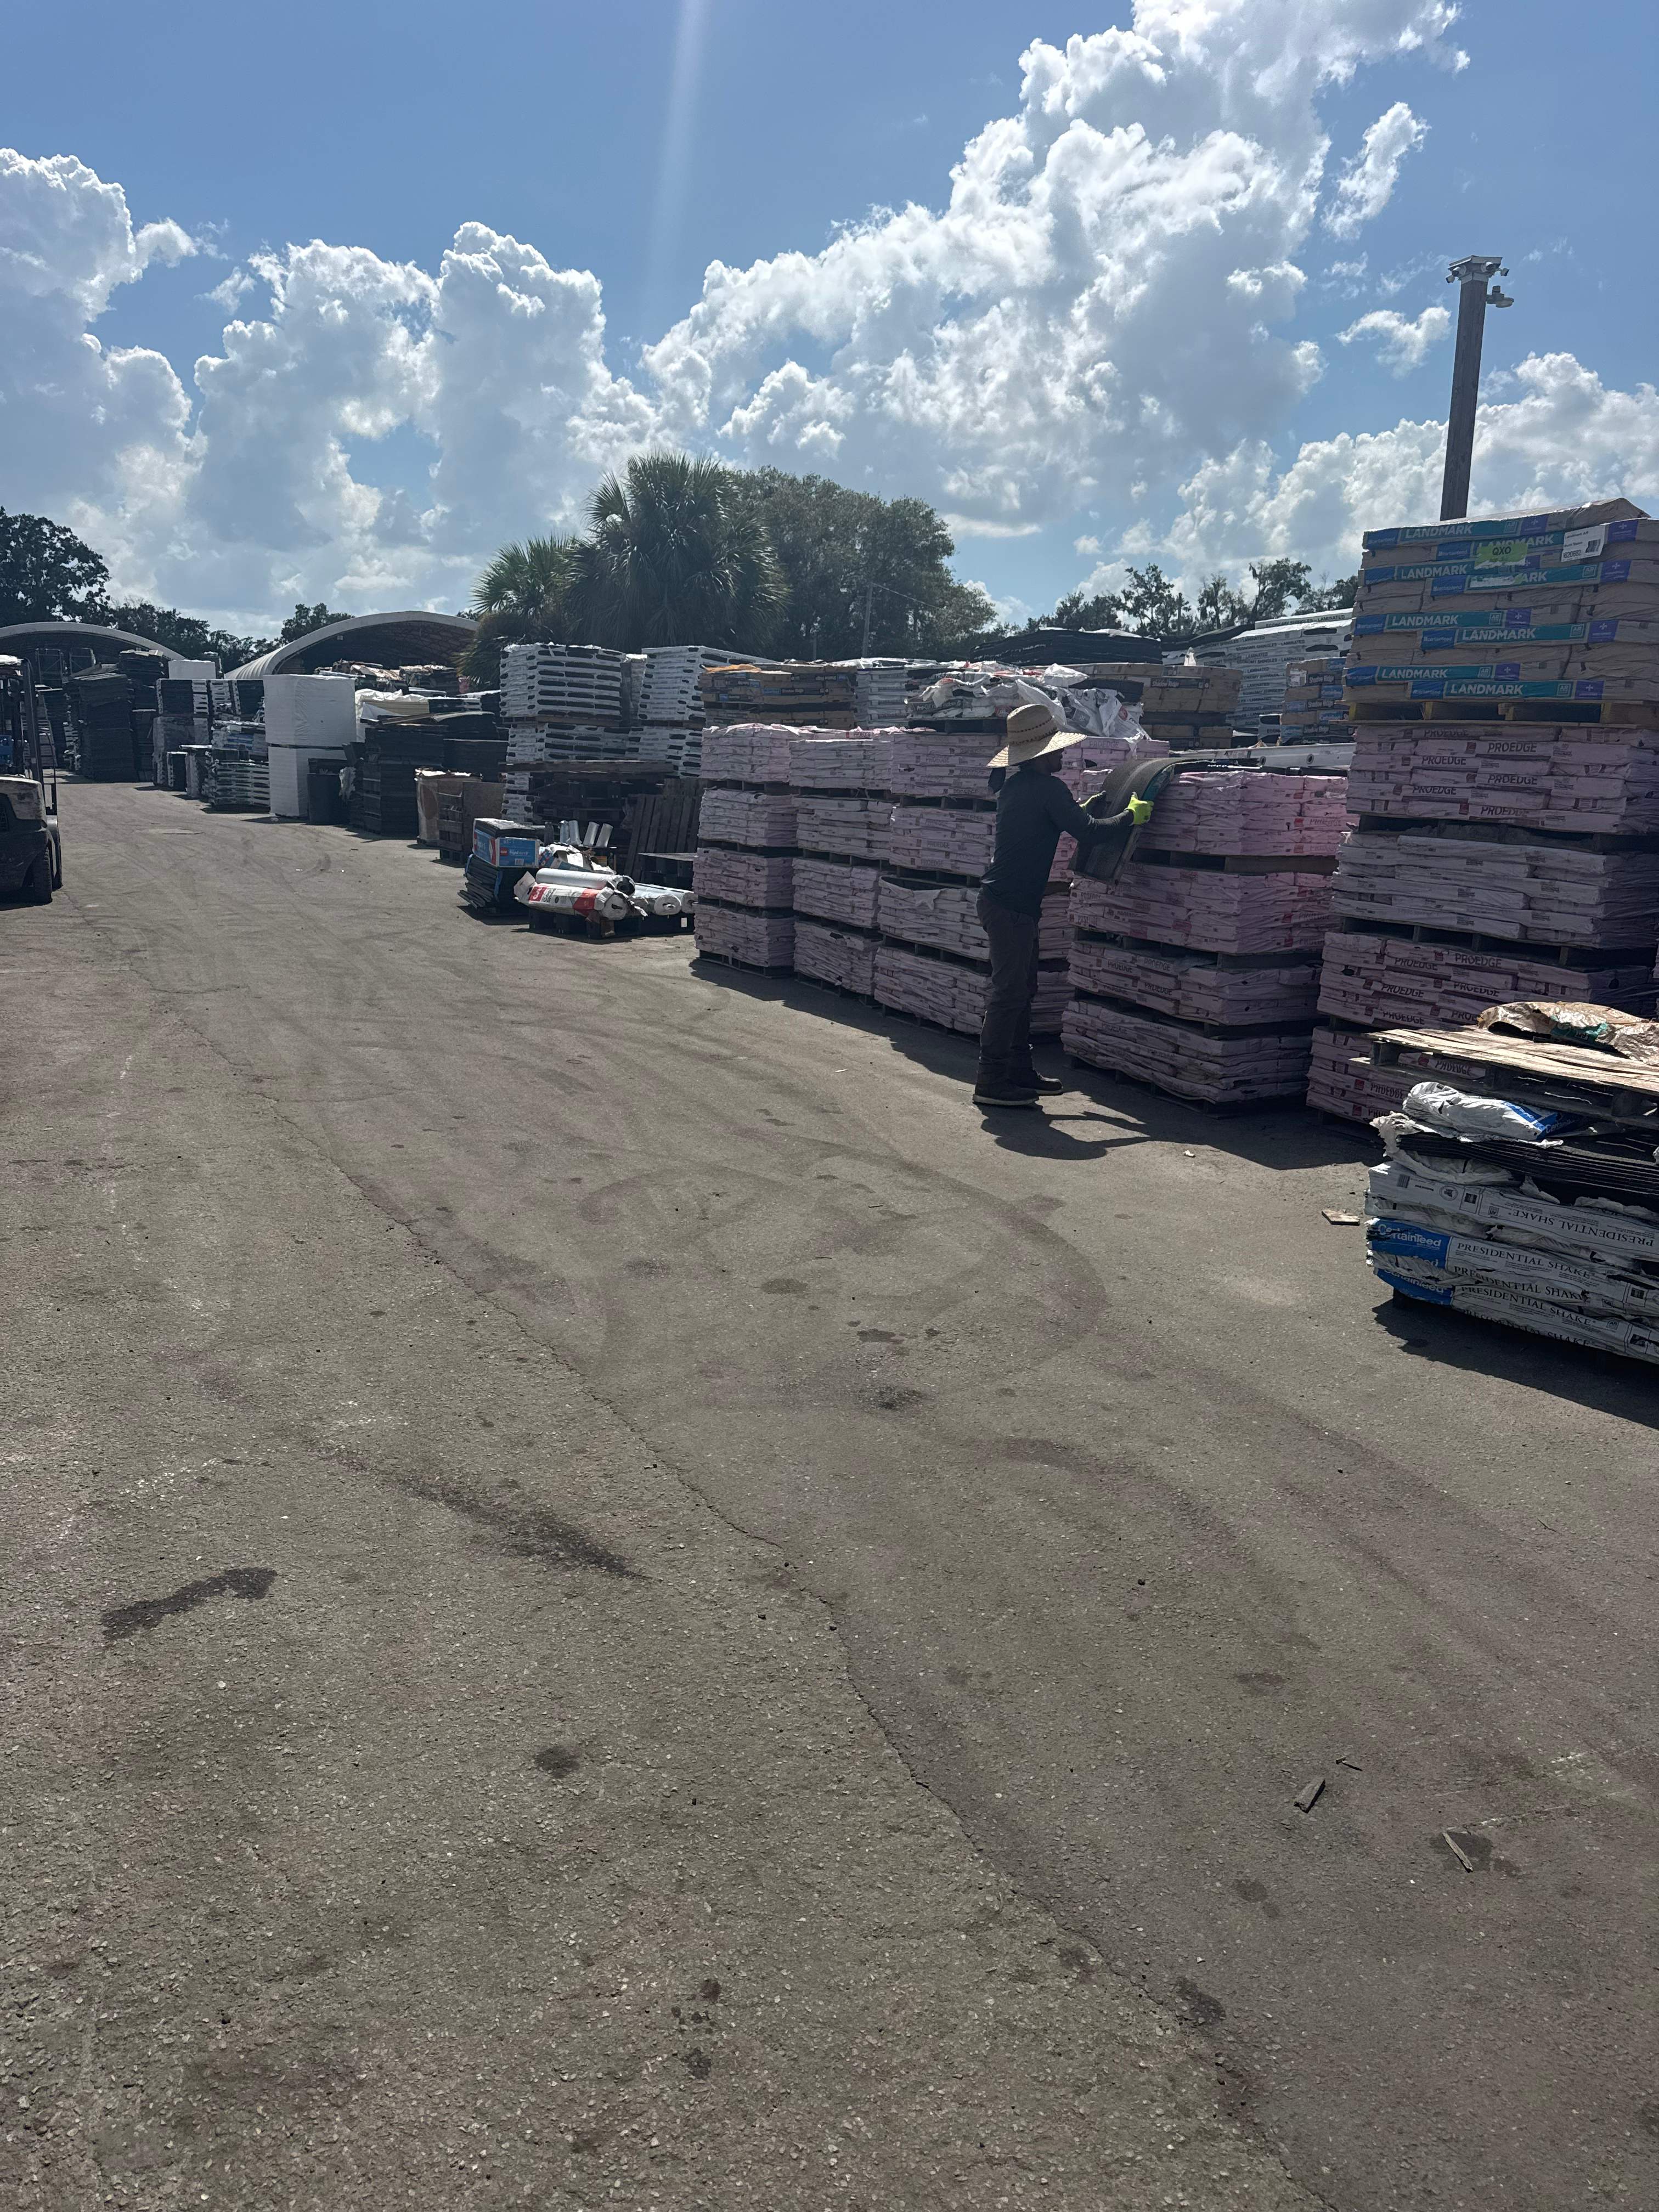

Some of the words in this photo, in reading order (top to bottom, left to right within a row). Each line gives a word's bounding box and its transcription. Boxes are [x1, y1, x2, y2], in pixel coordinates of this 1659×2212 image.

[1405, 524, 1474, 539] LANDMARK
[1492, 546, 1511, 555] QXO
[1401, 565, 1467, 579] LANDMARK
[1392, 614, 1458, 626] LANDMARK
[1462, 628, 1537, 640] LANDMARK
[1381, 669, 1449, 679] LANDMARK
[1450, 684, 1523, 695] LANDMARK
[1487, 742, 1538, 753] PROEDGE
[1421, 756, 1466, 765] PROEDGE
[1487, 775, 1538, 786] PROEDGE
[1412, 786, 1458, 795] PROEDGE
[1144, 956, 1171, 971] PROEDGE
[1395, 958, 1438, 971] PROEDGE
[1455, 953, 1502, 968] PROEDGE
[1381, 983, 1425, 998] PROEDGE
[1454, 982, 1500, 997] PROEDGE
[1513, 1209, 1555, 1225] SHAKE
[1560, 1220, 1655, 1247] PRESIDENTIAL
[1457, 1242, 1544, 1266] PRESIDENTIAL
[1549, 1261, 1590, 1279] SHAKE
[1454, 1266, 1541, 1293] PRESIDENTIAL
[1461, 1286, 1548, 1311] PRESIDENTIAL
[1550, 1307, 1592, 1327] SHAKE
